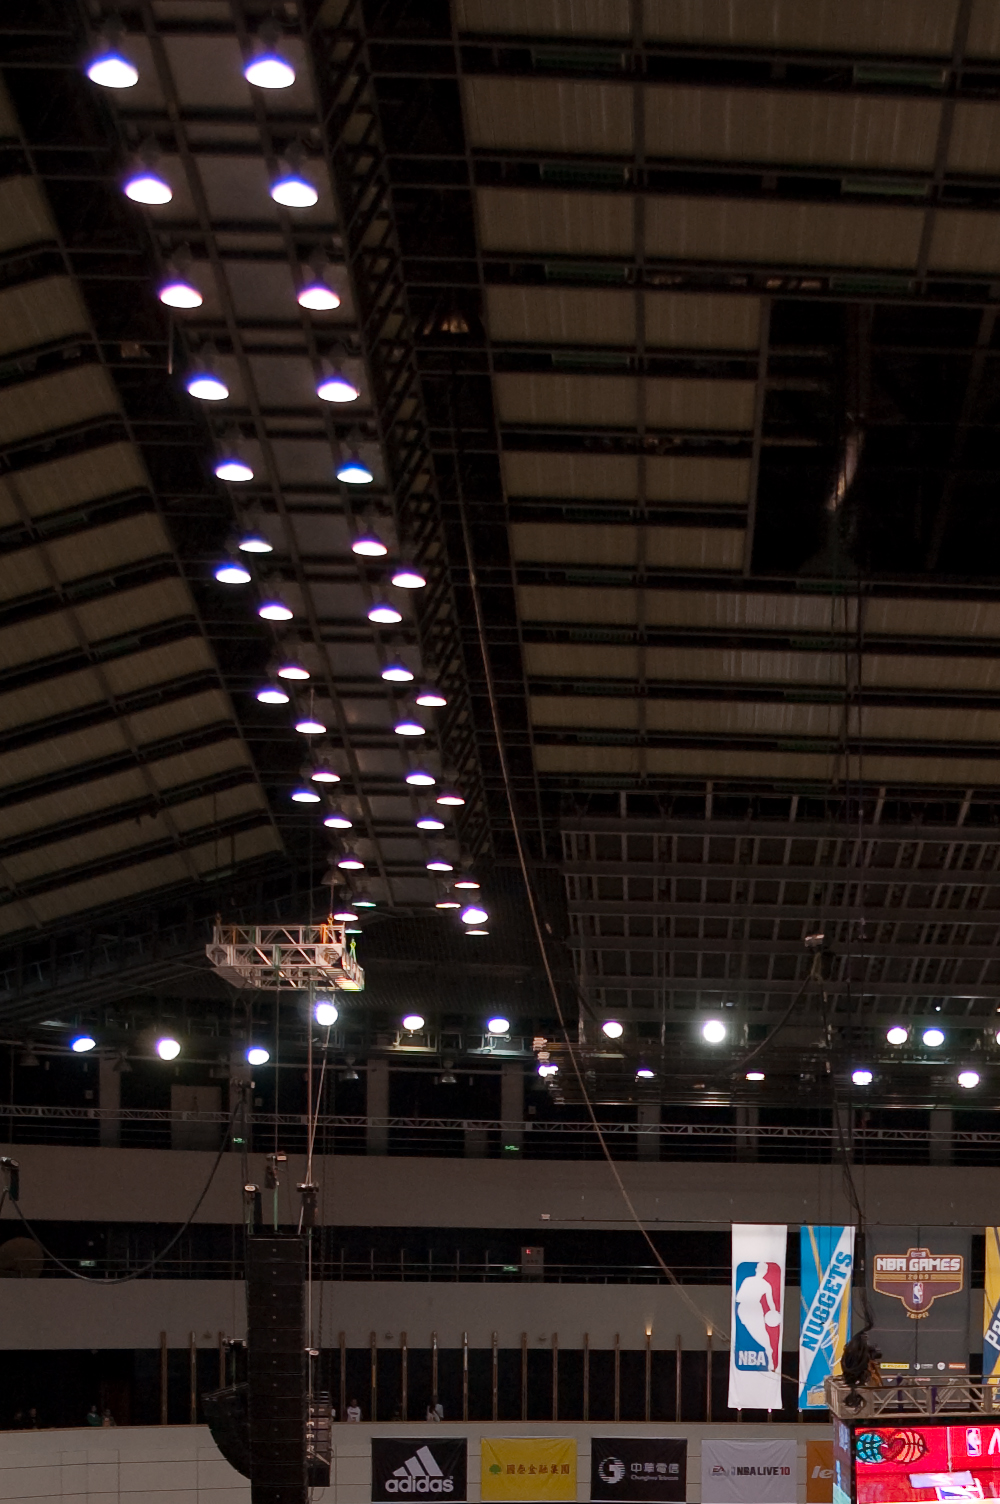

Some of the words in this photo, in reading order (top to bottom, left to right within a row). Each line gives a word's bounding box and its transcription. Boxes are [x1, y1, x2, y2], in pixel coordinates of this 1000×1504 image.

[877, 1258, 907, 1271] NBA
[909, 1258, 961, 1271] GAMES
[801, 1251, 852, 1352] NUGGETS
[738, 1350, 766, 1366] NBA
[736, 1466, 756, 1476] NBA
[757, 1466, 779, 1476] LIVE
[780, 1466, 791, 1476] 10
[385, 1475, 454, 1493] adidas
